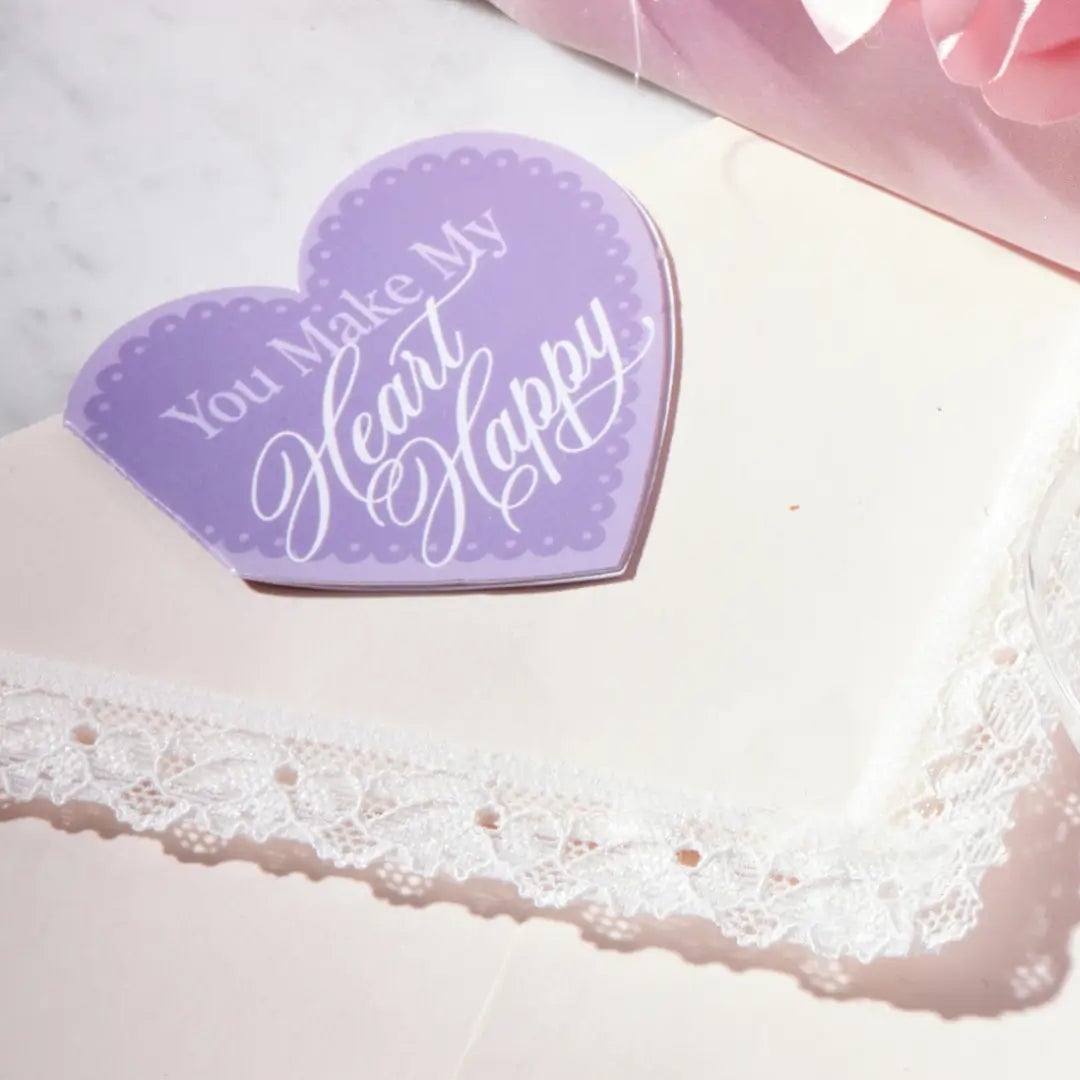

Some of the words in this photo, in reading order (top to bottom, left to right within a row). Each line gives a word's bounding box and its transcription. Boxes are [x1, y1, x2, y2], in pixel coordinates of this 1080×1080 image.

[159, 367, 283, 441] You
[267, 272, 425, 377] Make
[409, 207, 511, 281] My
[250, 256, 480, 565] Heart
[366, 296, 656, 569] Happy
